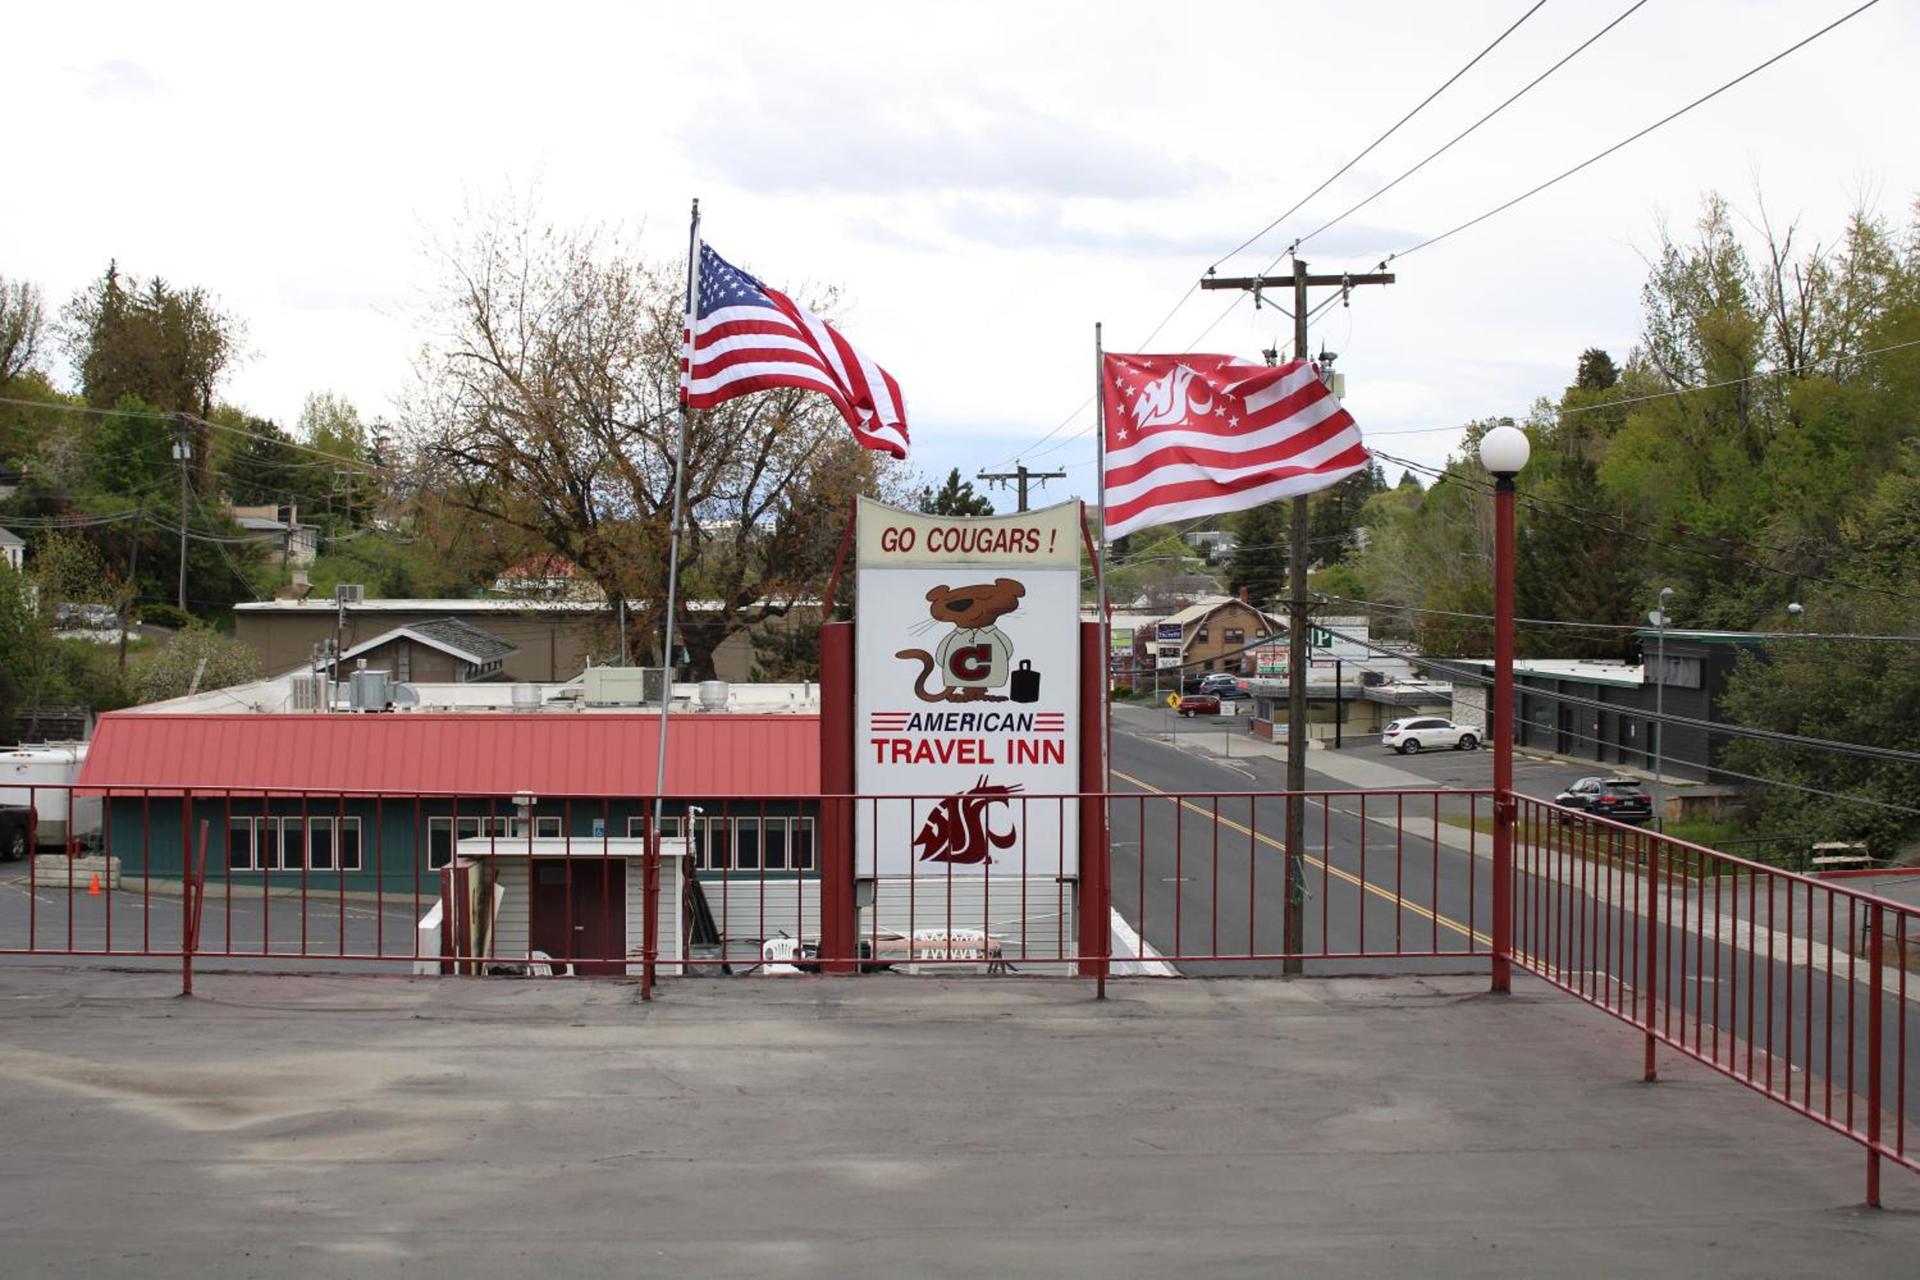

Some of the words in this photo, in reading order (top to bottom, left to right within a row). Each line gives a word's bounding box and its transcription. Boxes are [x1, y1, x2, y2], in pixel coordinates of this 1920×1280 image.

[881, 527, 916, 553] GO
[927, 527, 1040, 553] COUGARS
[907, 712, 1034, 732] AMERICAN
[871, 739, 994, 764] TRAVEL
[1008, 739, 1065, 764] INN
